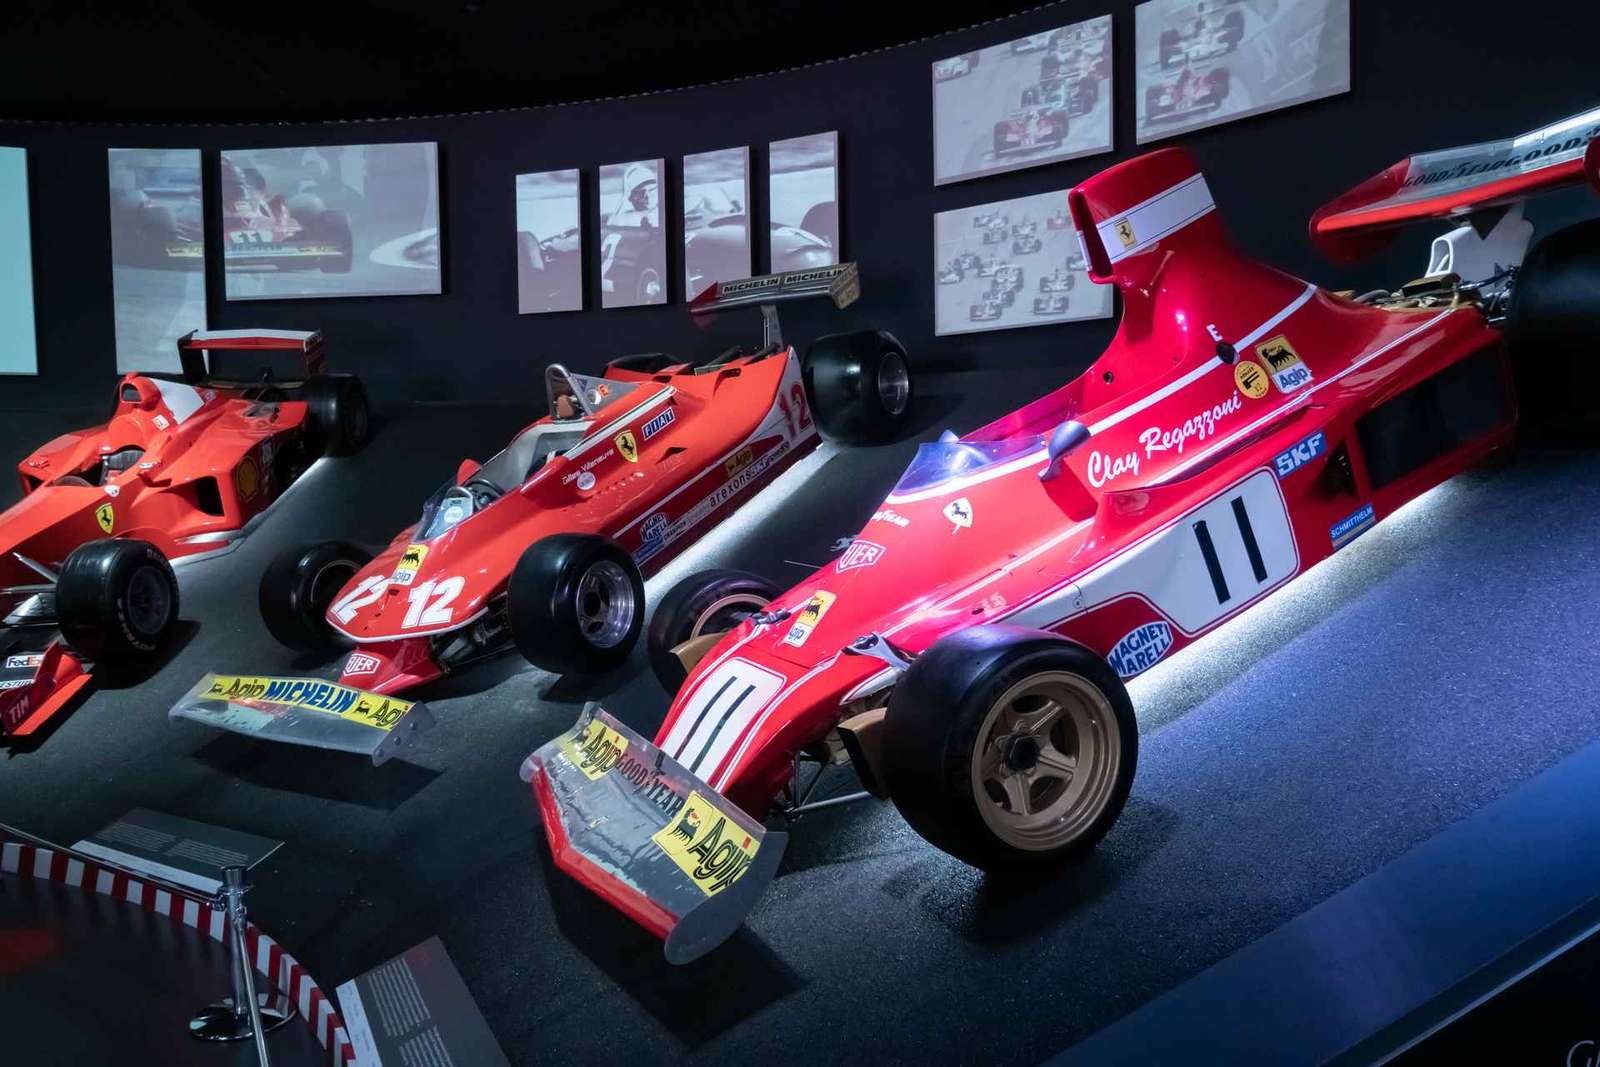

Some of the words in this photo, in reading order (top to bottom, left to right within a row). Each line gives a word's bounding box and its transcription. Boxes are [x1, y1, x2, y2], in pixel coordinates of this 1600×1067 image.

[724, 279, 778, 292] MICHELIN
[1206, 324, 1223, 341] E
[1279, 367, 1308, 388] Agip
[643, 408, 675, 439] FIAT
[776, 383, 811, 438] 12
[1087, 451, 1140, 488] Clay
[1139, 391, 1242, 459] Regazzoni
[1275, 432, 1323, 476] SKF
[709, 470, 752, 507] arexons
[1192, 496, 1268, 605] 11
[401, 576, 466, 629] 12
[9, 695, 30, 723] TIM
[265, 681, 358, 713] MICHELIN
[672, 676, 757, 773] 11
